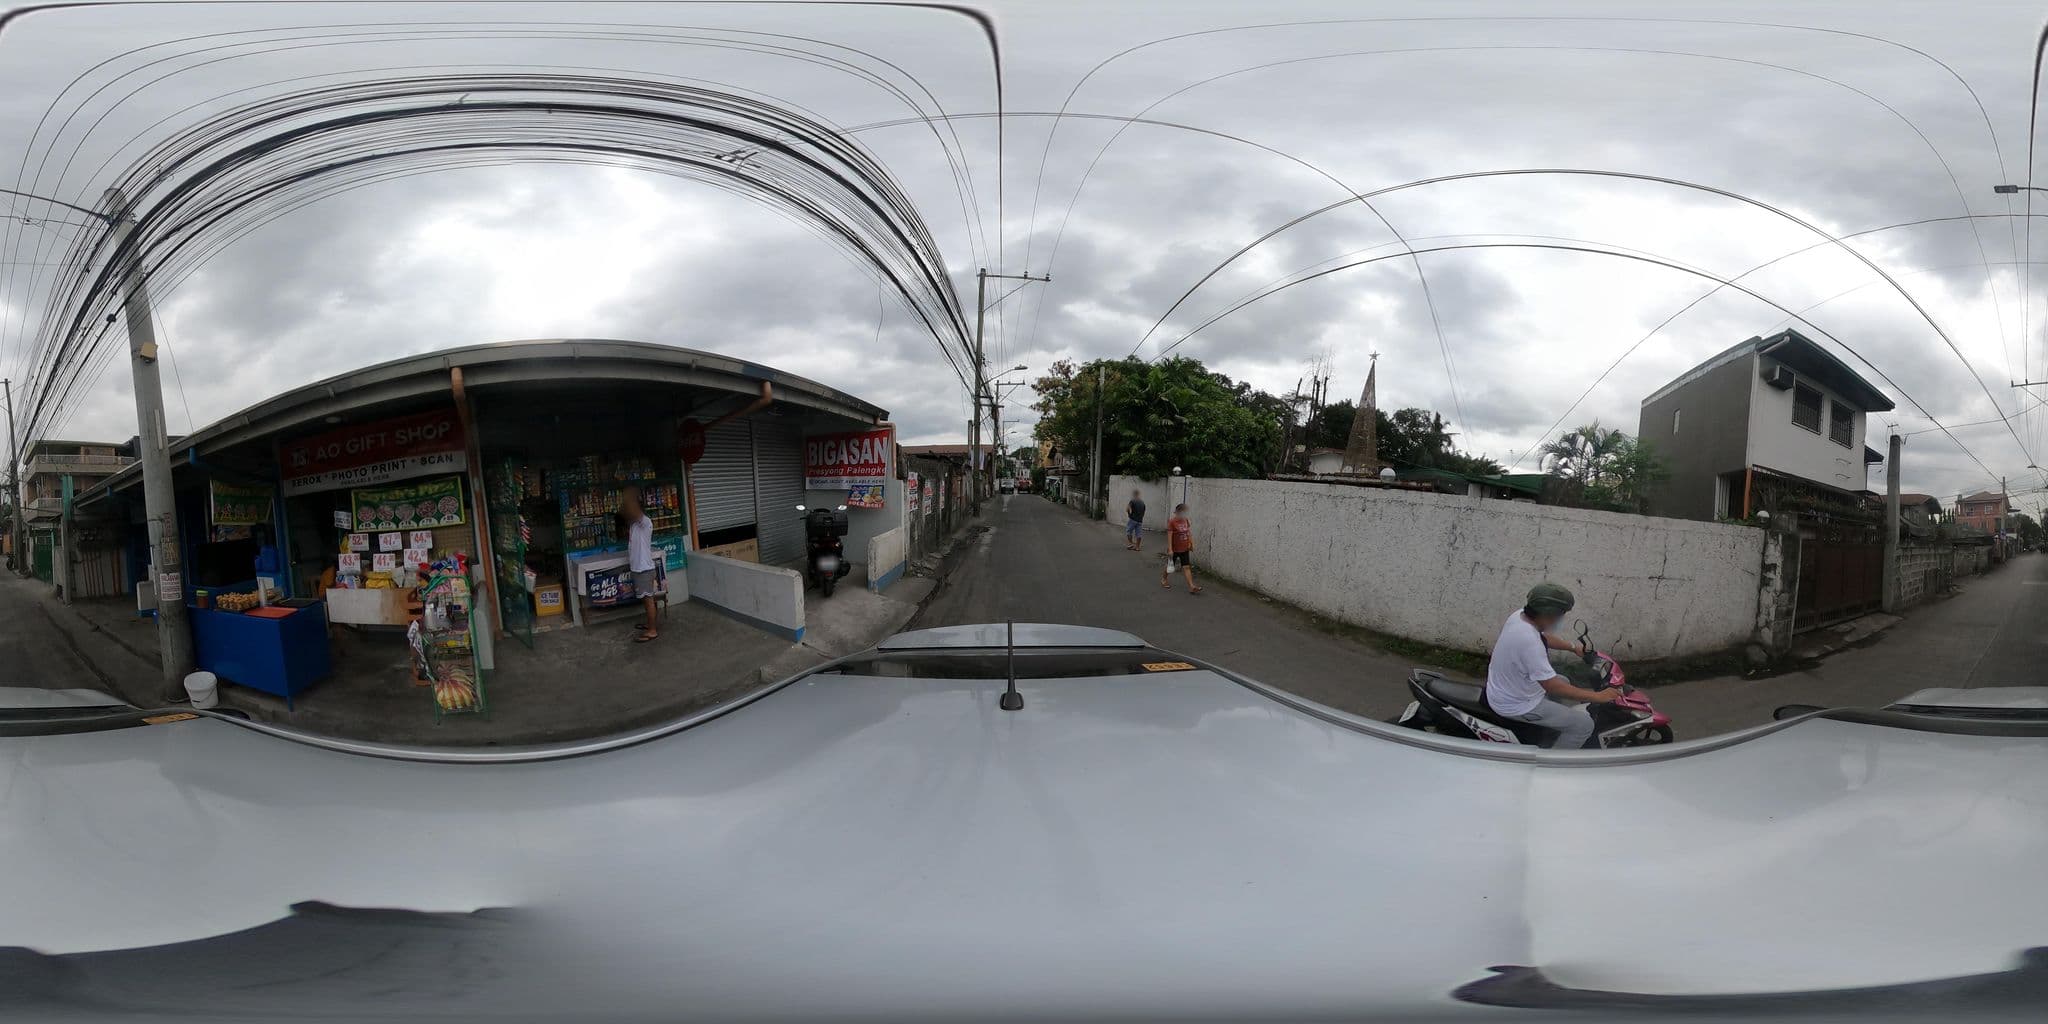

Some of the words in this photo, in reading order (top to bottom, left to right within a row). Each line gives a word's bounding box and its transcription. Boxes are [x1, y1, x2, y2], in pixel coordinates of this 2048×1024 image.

[345, 431, 387, 454] GIFT
[395, 422, 450, 445] SHOP
[808, 437, 888, 466] BIGASAN
[331, 467, 368, 481] PHOTO
[371, 459, 407, 474] PRINT
[420, 453, 454, 466] SCAN
[807, 466, 844, 476] Presyong
[601, 577, 616, 589] ALL
